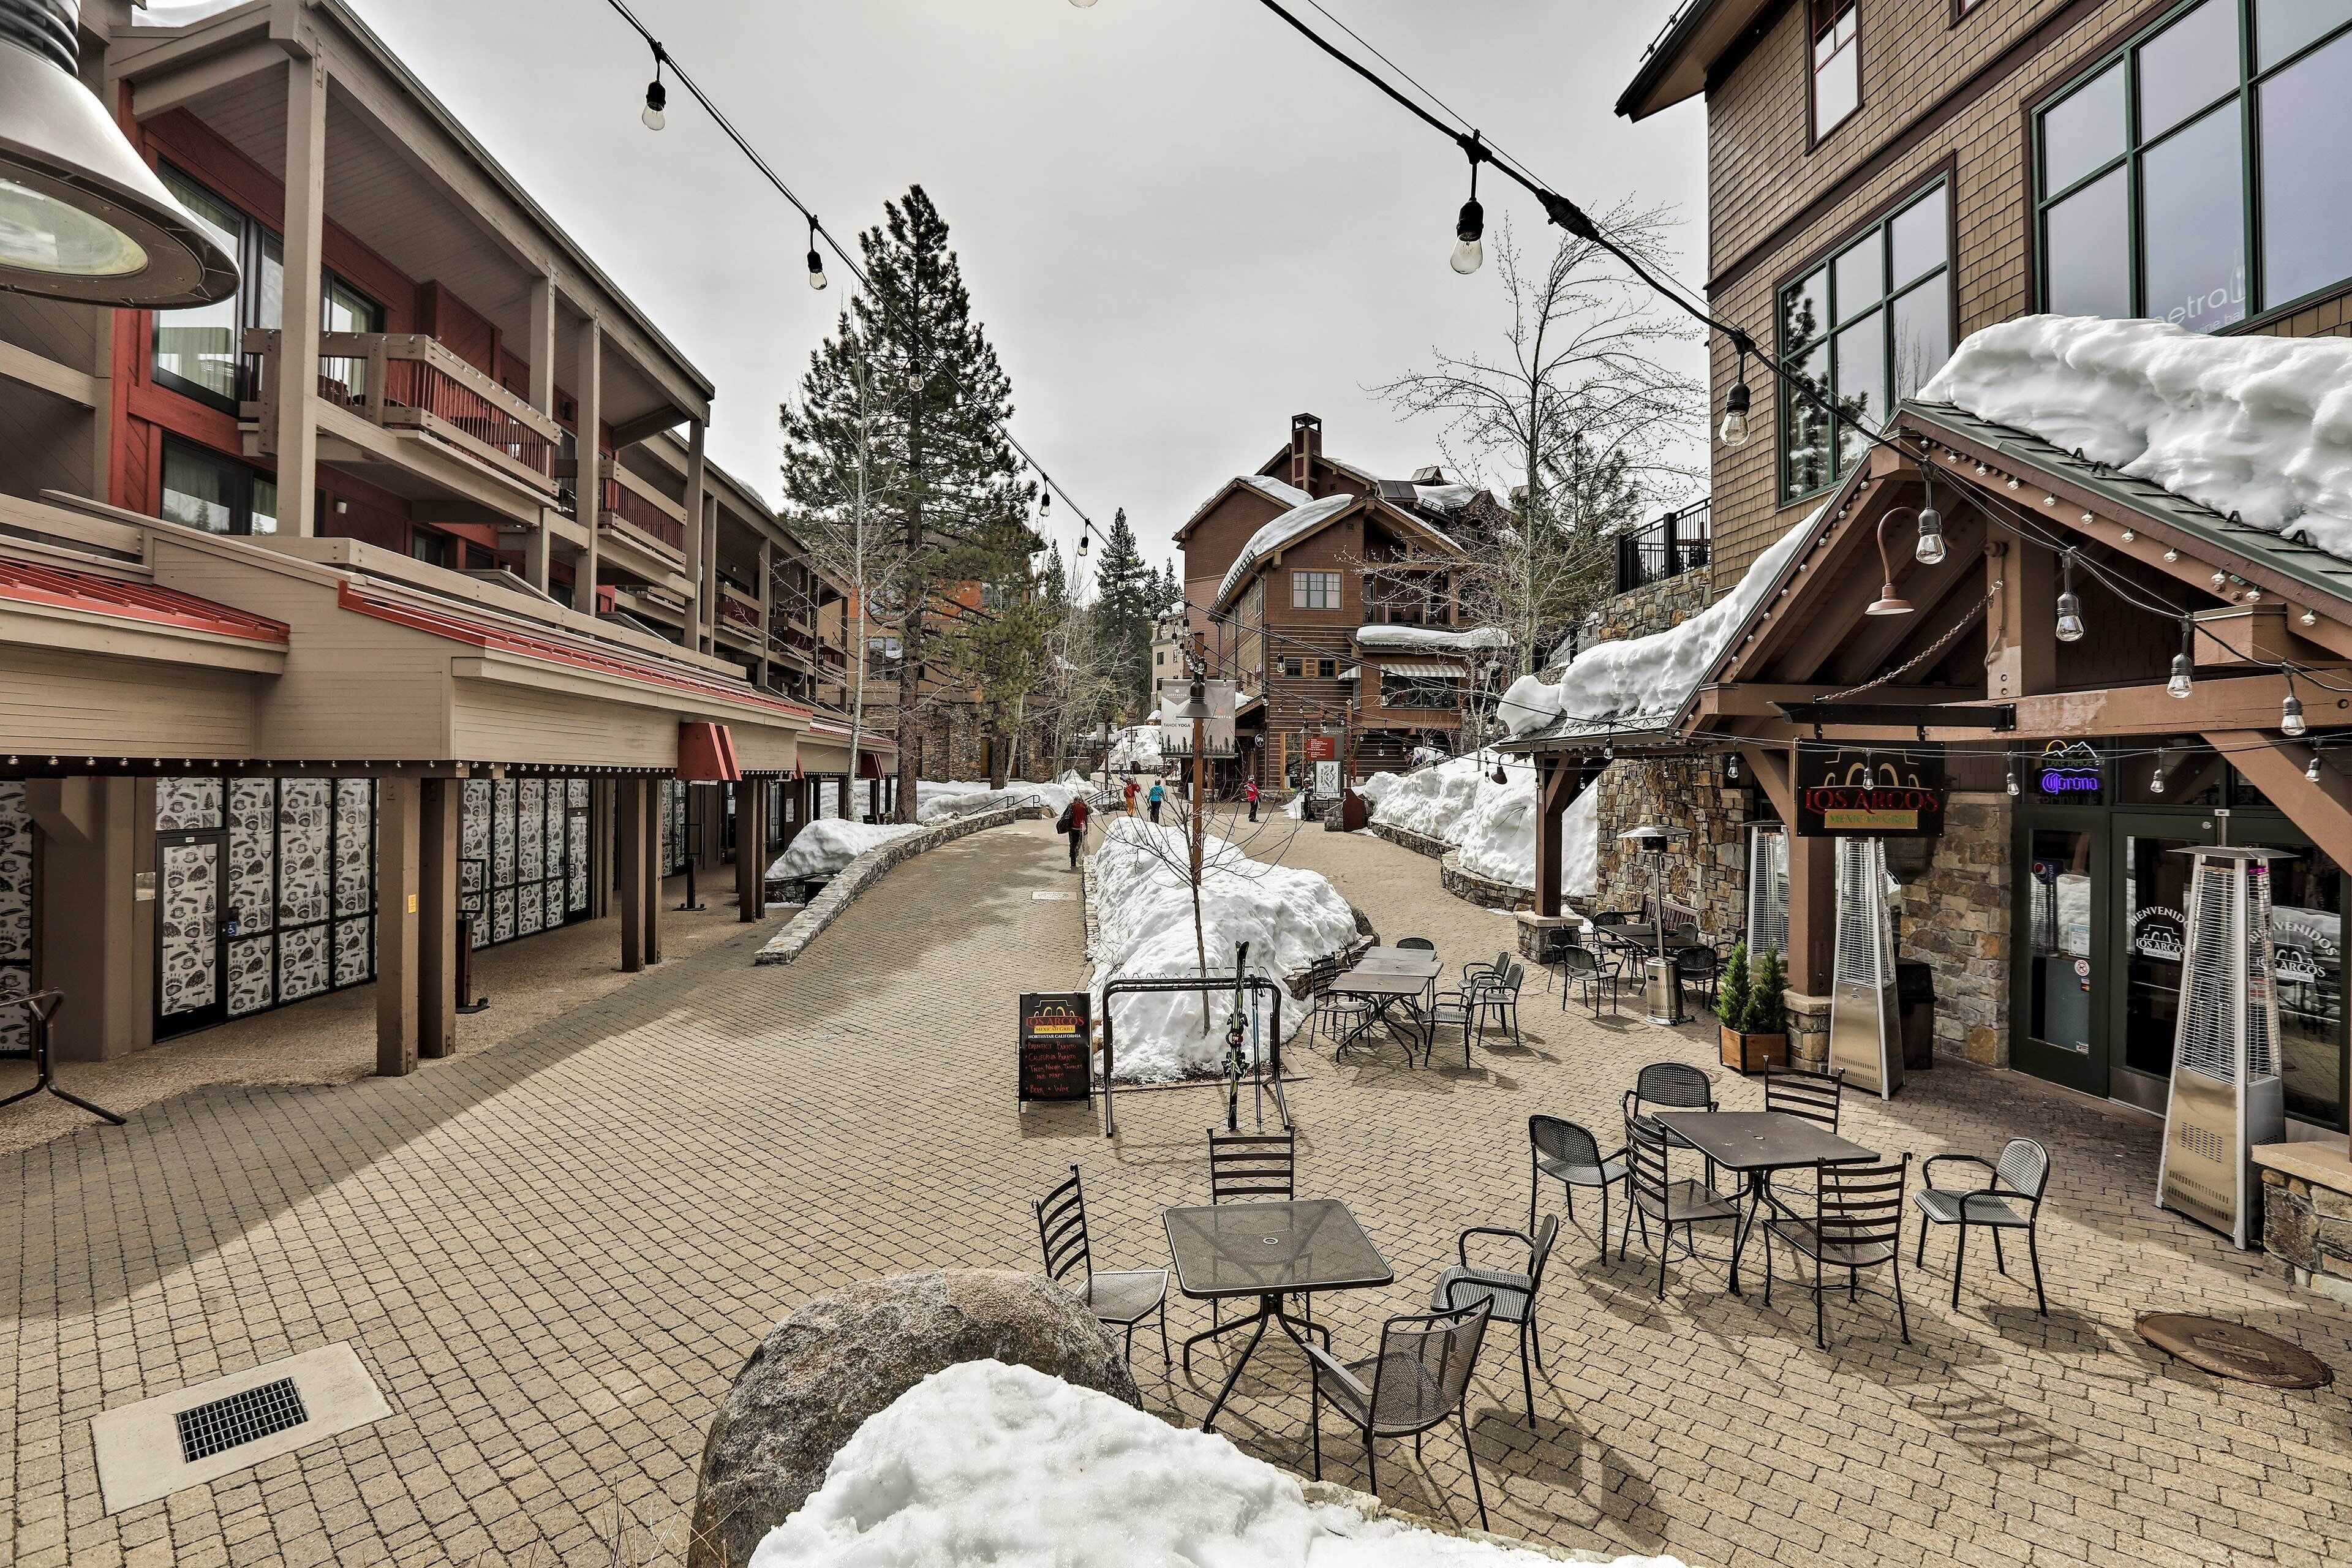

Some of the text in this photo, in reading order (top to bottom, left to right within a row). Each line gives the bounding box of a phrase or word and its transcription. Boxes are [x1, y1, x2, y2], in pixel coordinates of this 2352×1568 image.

[2154, 287, 2228, 325] etra
[2041, 772, 2098, 795] Corona
[1805, 789, 1939, 815] LOS ARCOS
[1830, 814, 1880, 824] MEXICAN
[2130, 906, 2188, 930] BIENVENIDO
[2136, 938, 2152, 949] LOS
[2280, 960, 2326, 977] ARCOS
[1025, 1017, 1084, 1028] LOS ARCOS
